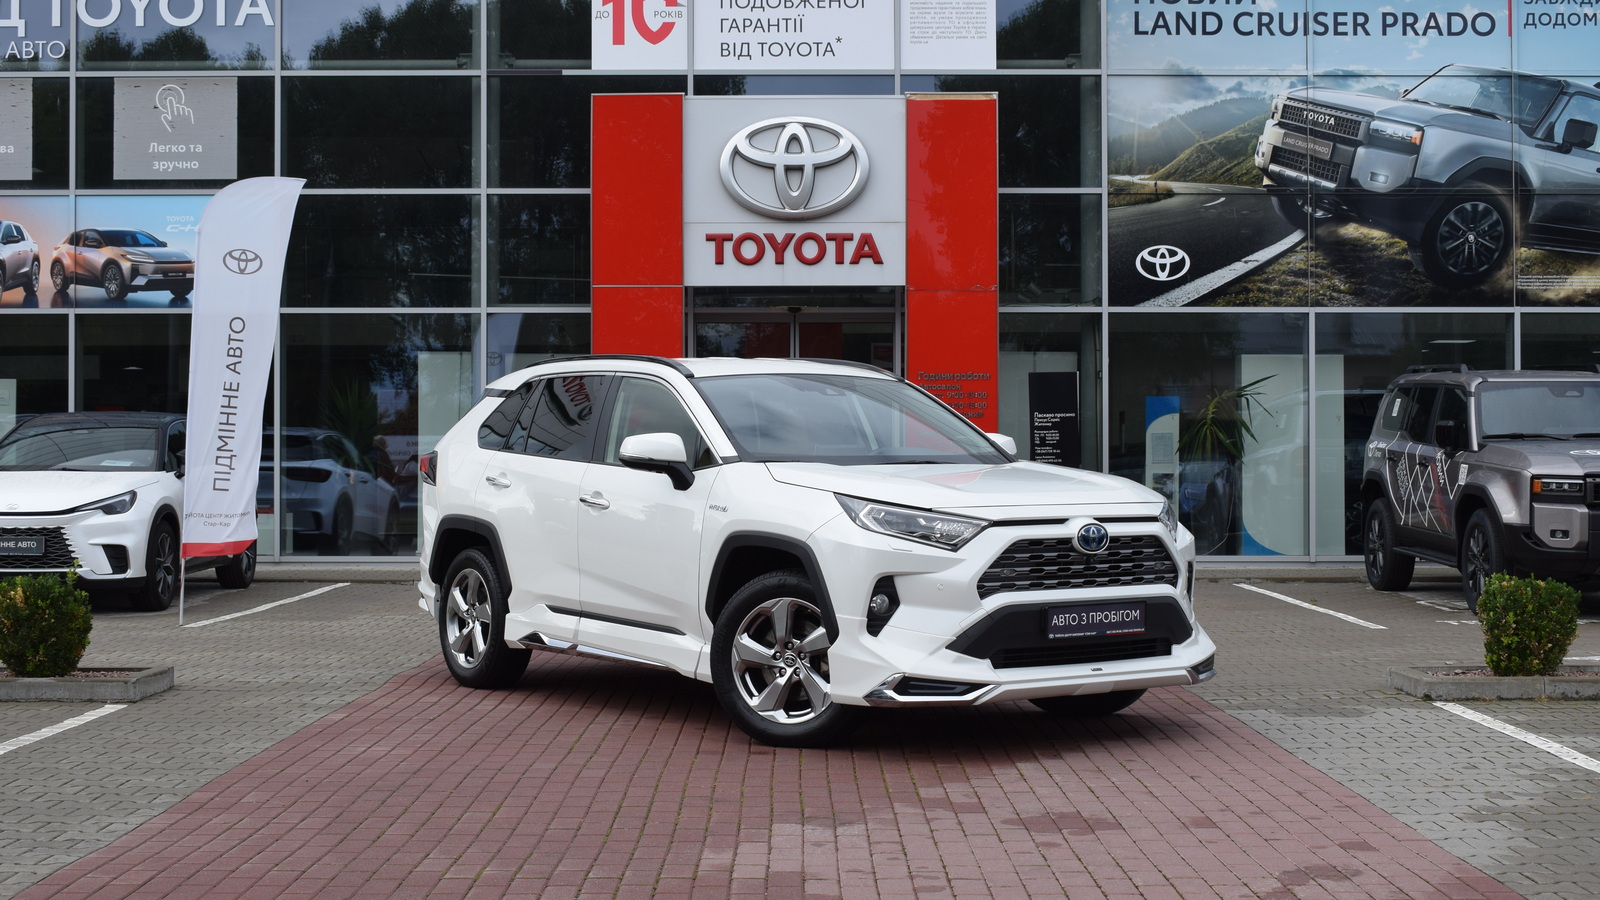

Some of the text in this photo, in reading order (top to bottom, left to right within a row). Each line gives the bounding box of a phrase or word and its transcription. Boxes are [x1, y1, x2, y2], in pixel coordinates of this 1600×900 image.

[595, 11, 610, 20] ДО
[654, 10, 683, 18] РОКІВ
[720, 14, 804, 32] ГАРАНТІЇ
[1524, 12, 1600, 29] ДОДОМ
[1134, 12, 1496, 36] LAND CRUISER PRADO
[5, 40, 66, 58] АВТО
[720, 42, 752, 60] ВІД
[1303, 111, 1334, 126] TOYOTA
[0, 145, 14, 154] ва
[148, 143, 202, 152] Легко та
[152, 160, 199, 171] зручно
[705, 232, 884, 266] TOYOTA
[918, 372, 990, 382] Години роботи
[212, 316, 246, 492] ПІДМІННЕ АВТО
[1052, 610, 1140, 626] АВТО З ПРОБІГОМ
